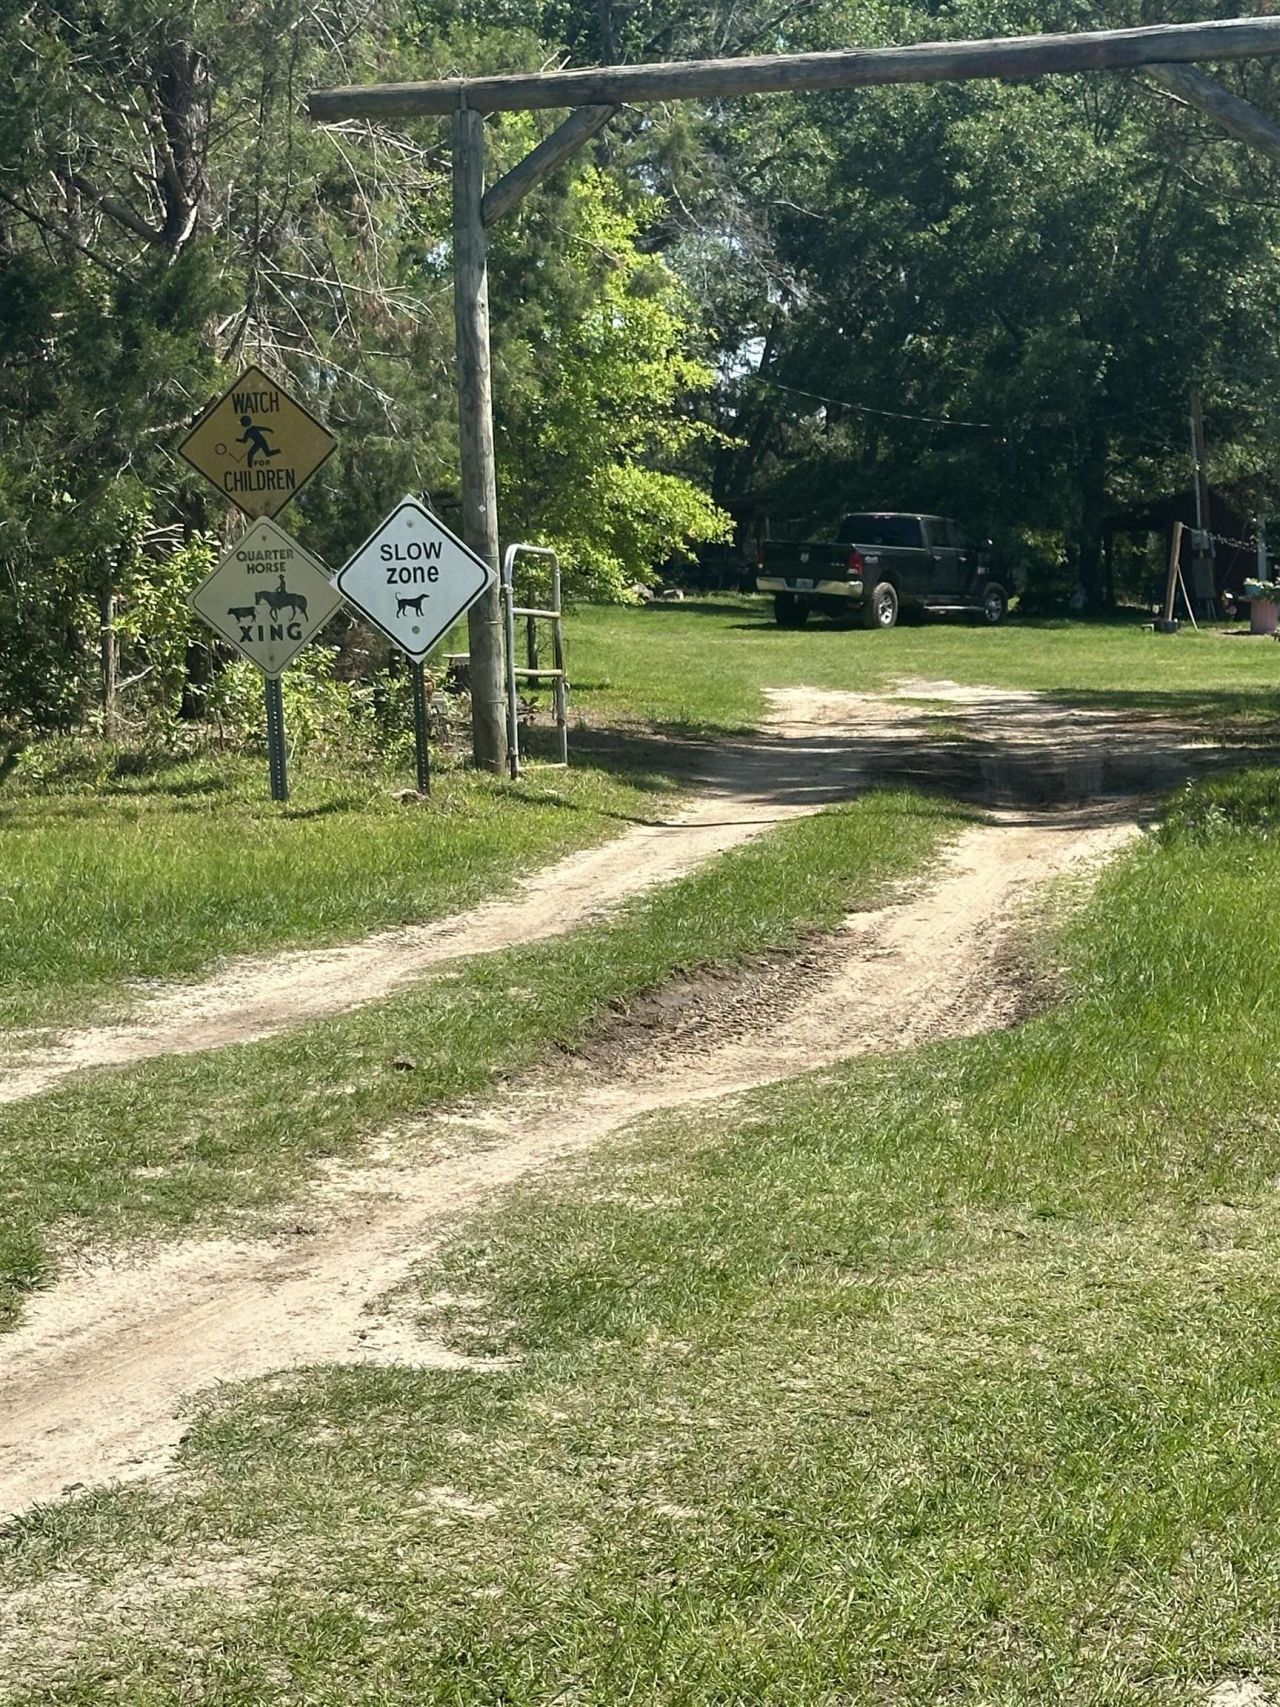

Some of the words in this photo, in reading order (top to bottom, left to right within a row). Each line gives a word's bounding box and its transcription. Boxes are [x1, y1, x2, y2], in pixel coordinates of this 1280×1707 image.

[232, 392, 279, 413] WATCH
[225, 469, 295, 491] CHILDREN
[237, 549, 294, 561] QUARTER
[380, 542, 442, 561] SLOW
[246, 563, 286, 574] HORSE
[387, 566, 439, 584] zone
[240, 623, 302, 642] XING
